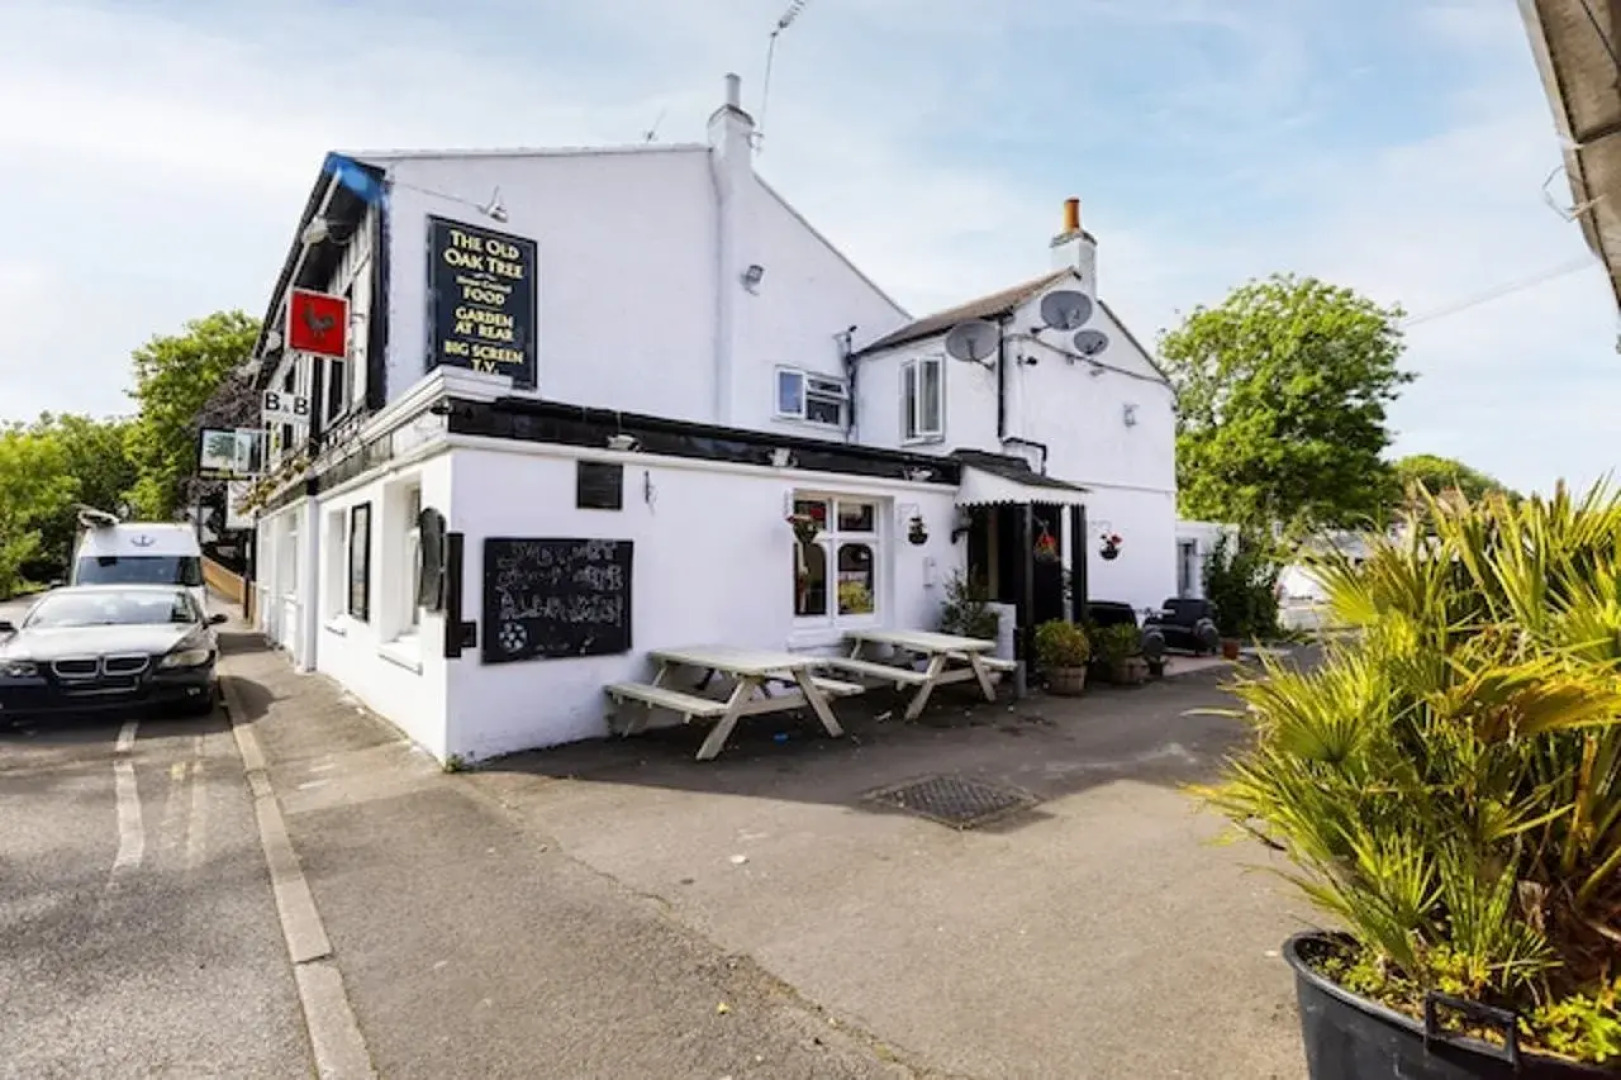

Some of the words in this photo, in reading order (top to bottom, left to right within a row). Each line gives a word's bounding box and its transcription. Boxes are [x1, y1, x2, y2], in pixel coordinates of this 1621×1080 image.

[450, 230, 483, 251] THE
[486, 240, 519, 259] OLD
[443, 248, 484, 269] OAK
[486, 257, 523, 279] TREE
[463, 286, 505, 305] FOOD
[455, 306, 514, 329] GARDEN
[454, 320, 473, 335] AT
[478, 324, 514, 341] REAR
[445, 341, 469, 356] BIG
[472, 344, 523, 363] SCREEN
[265, 393, 279, 410] B
[294, 397, 308, 415] B
